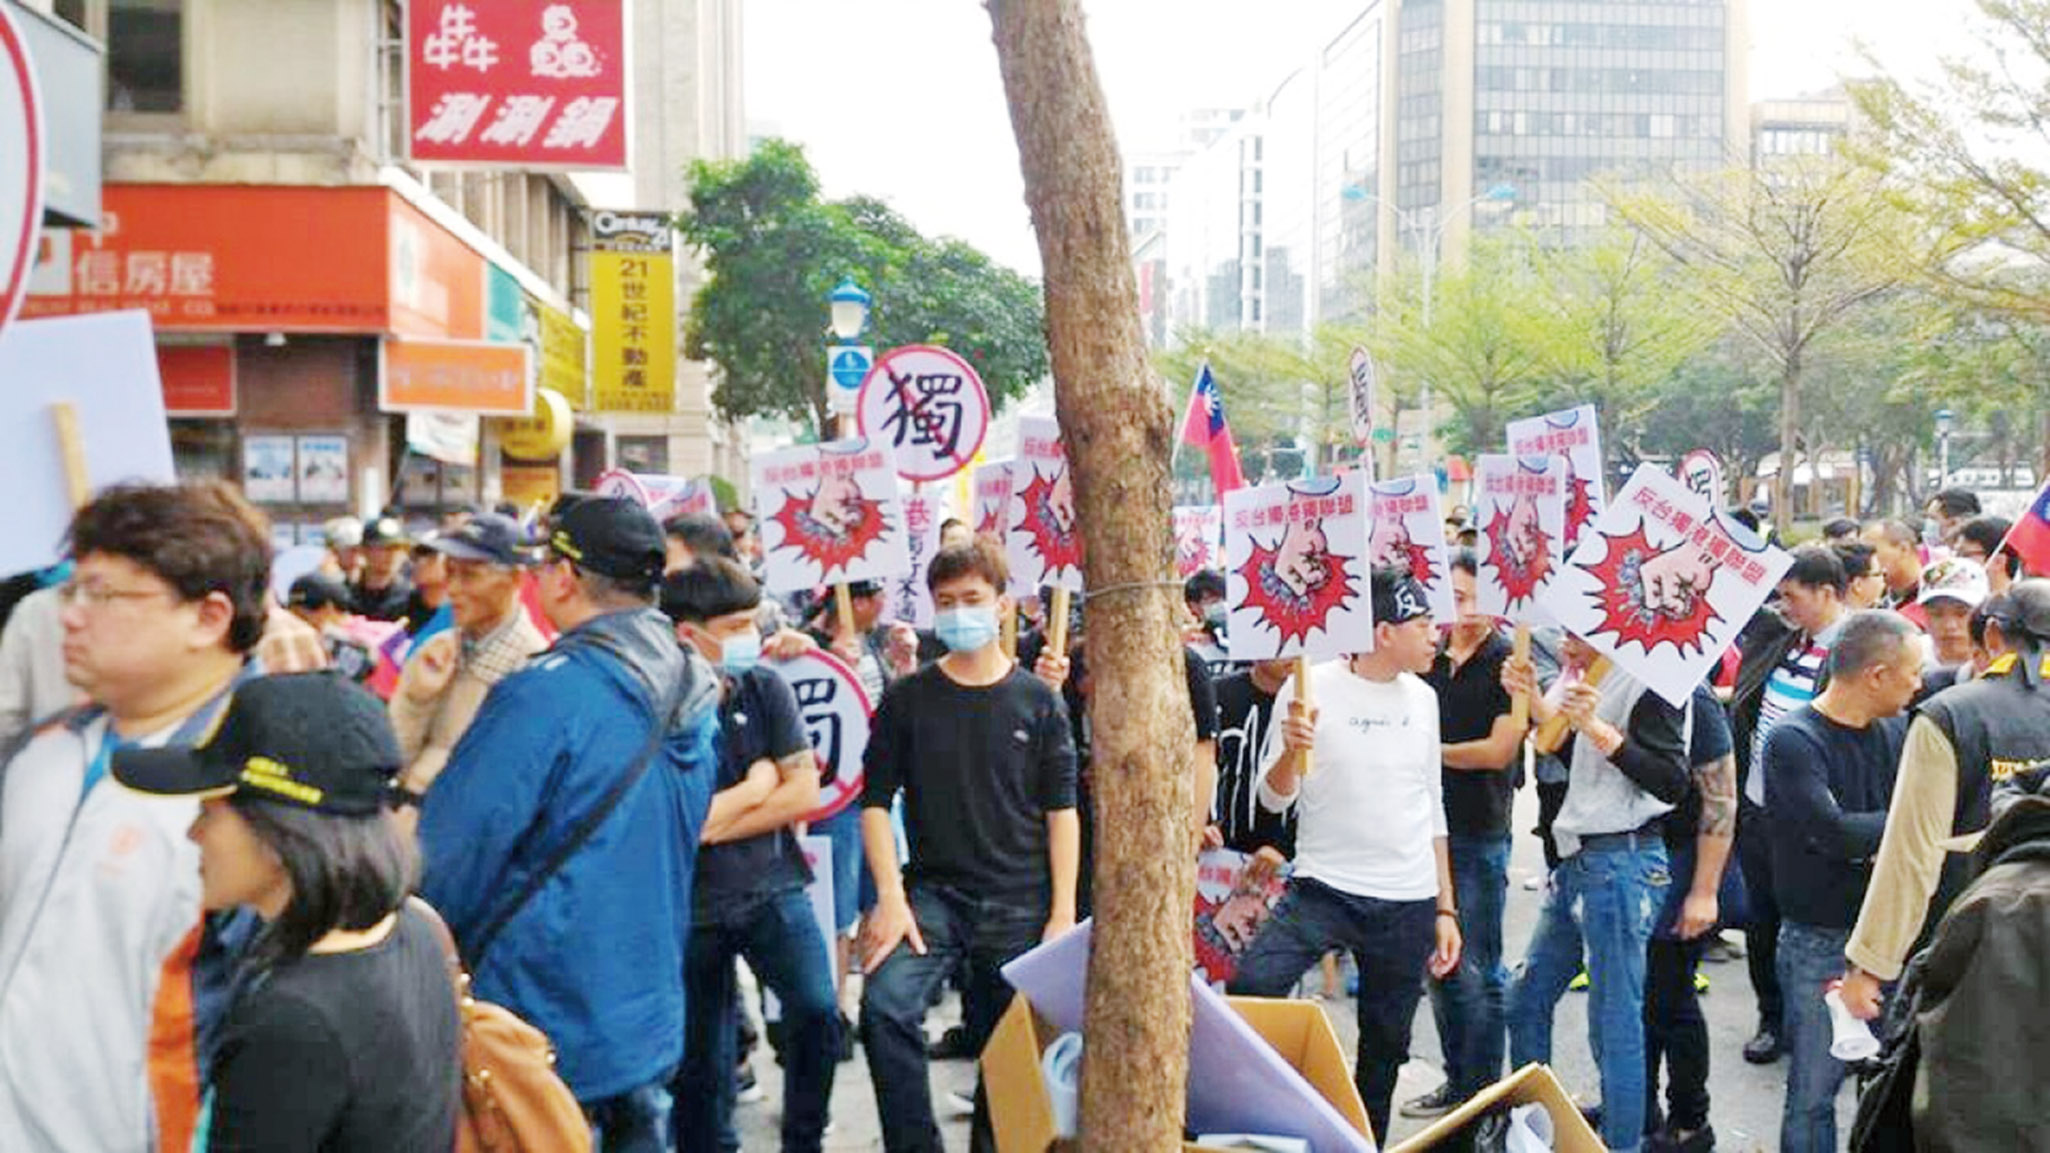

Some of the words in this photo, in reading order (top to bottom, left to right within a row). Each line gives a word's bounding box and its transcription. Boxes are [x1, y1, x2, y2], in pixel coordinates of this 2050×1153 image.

[415, 93, 619, 148] 涮涮鍋
[880, 372, 963, 460] 獨
